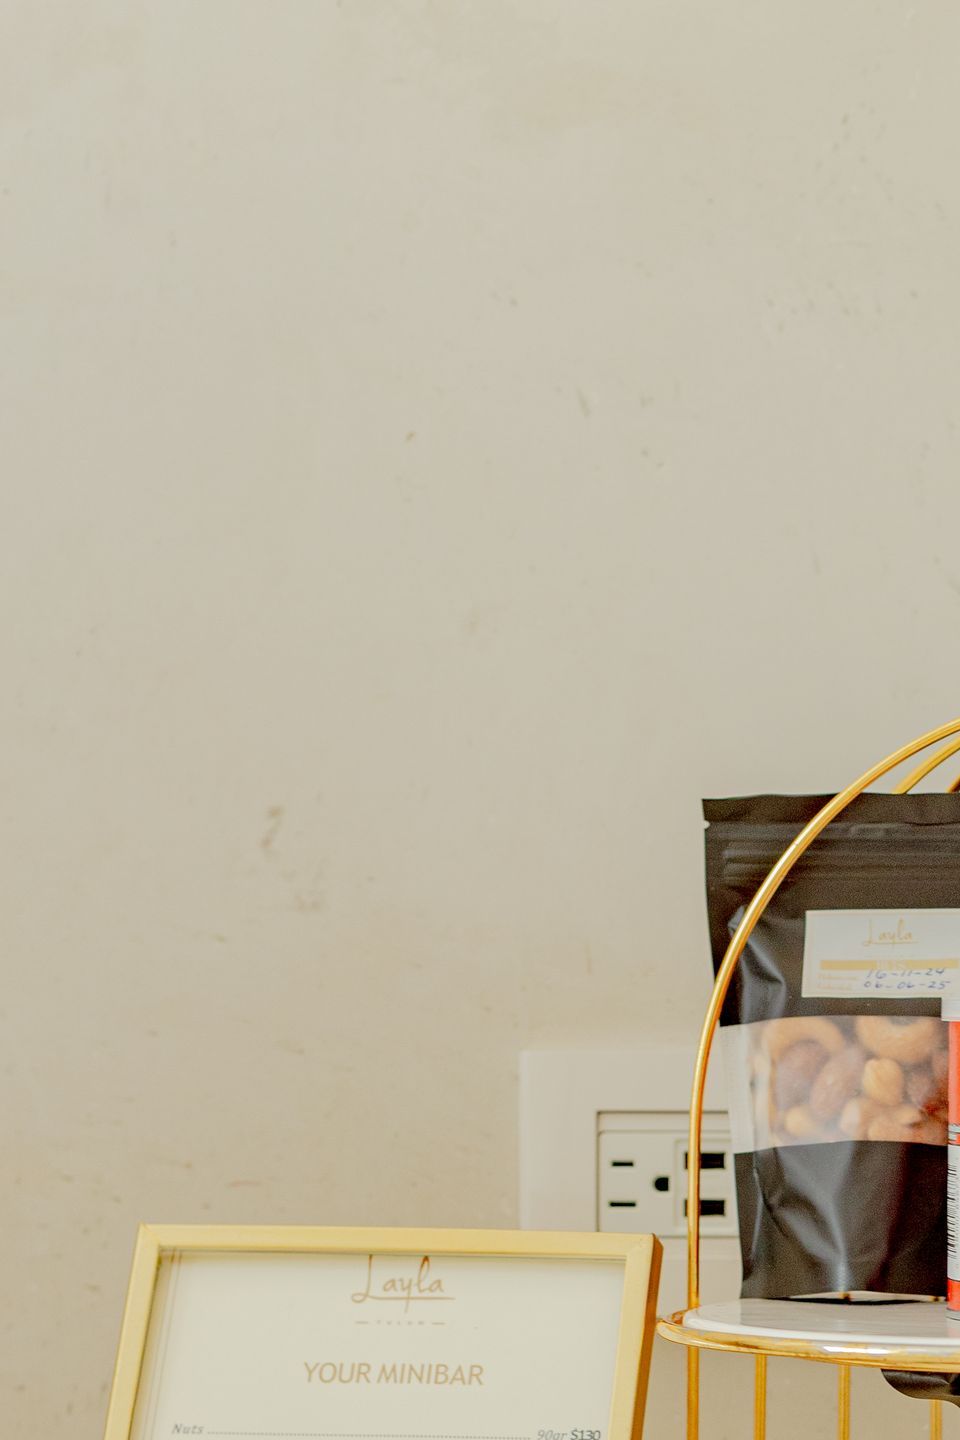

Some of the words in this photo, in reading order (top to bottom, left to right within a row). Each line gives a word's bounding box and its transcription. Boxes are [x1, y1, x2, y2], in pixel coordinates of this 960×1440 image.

[863, 917, 919, 946] Layla
[352, 1254, 456, 1314] Layla
[304, 1361, 372, 1384] YOUR
[376, 1362, 485, 1386] MINIBAR
[171, 1423, 204, 1435] Nuts
